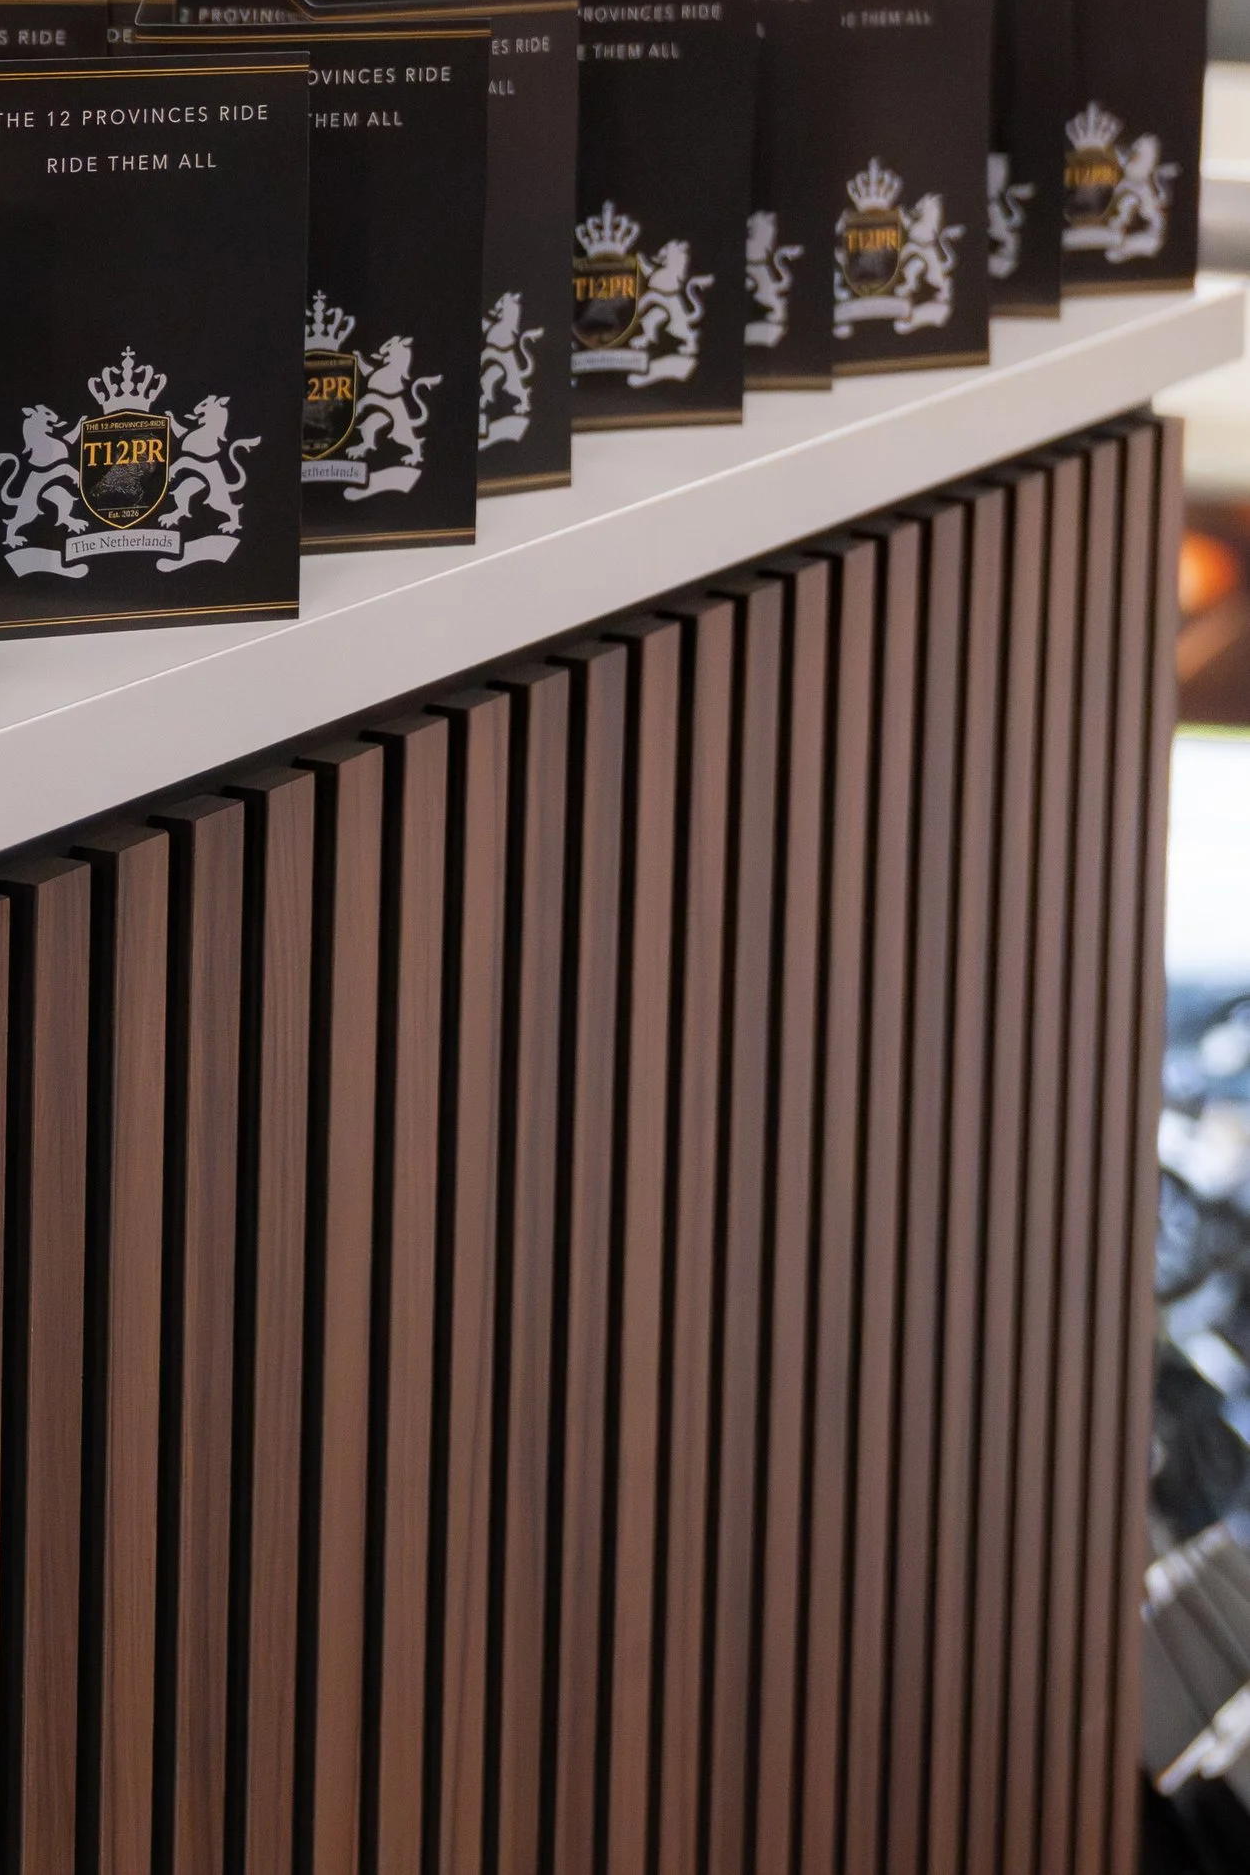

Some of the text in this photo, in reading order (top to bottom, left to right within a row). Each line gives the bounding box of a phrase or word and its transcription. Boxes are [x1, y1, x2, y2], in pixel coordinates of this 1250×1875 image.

[18, 29, 67, 46] RIDE
[515, 35, 550, 55] RIDE
[405, 65, 452, 83] RIDE
[46, 110, 71, 127] 12
[82, 106, 208, 126] PROVINCES
[219, 104, 269, 122] RIDE
[366, 110, 404, 128] ALL
[47, 152, 218, 174] RIDE THEM ALL
[573, 275, 636, 303] T12PR
[85, 423, 100, 432] THE
[83, 438, 166, 468] T12PR
[71, 535, 174, 554] The Netherlands
